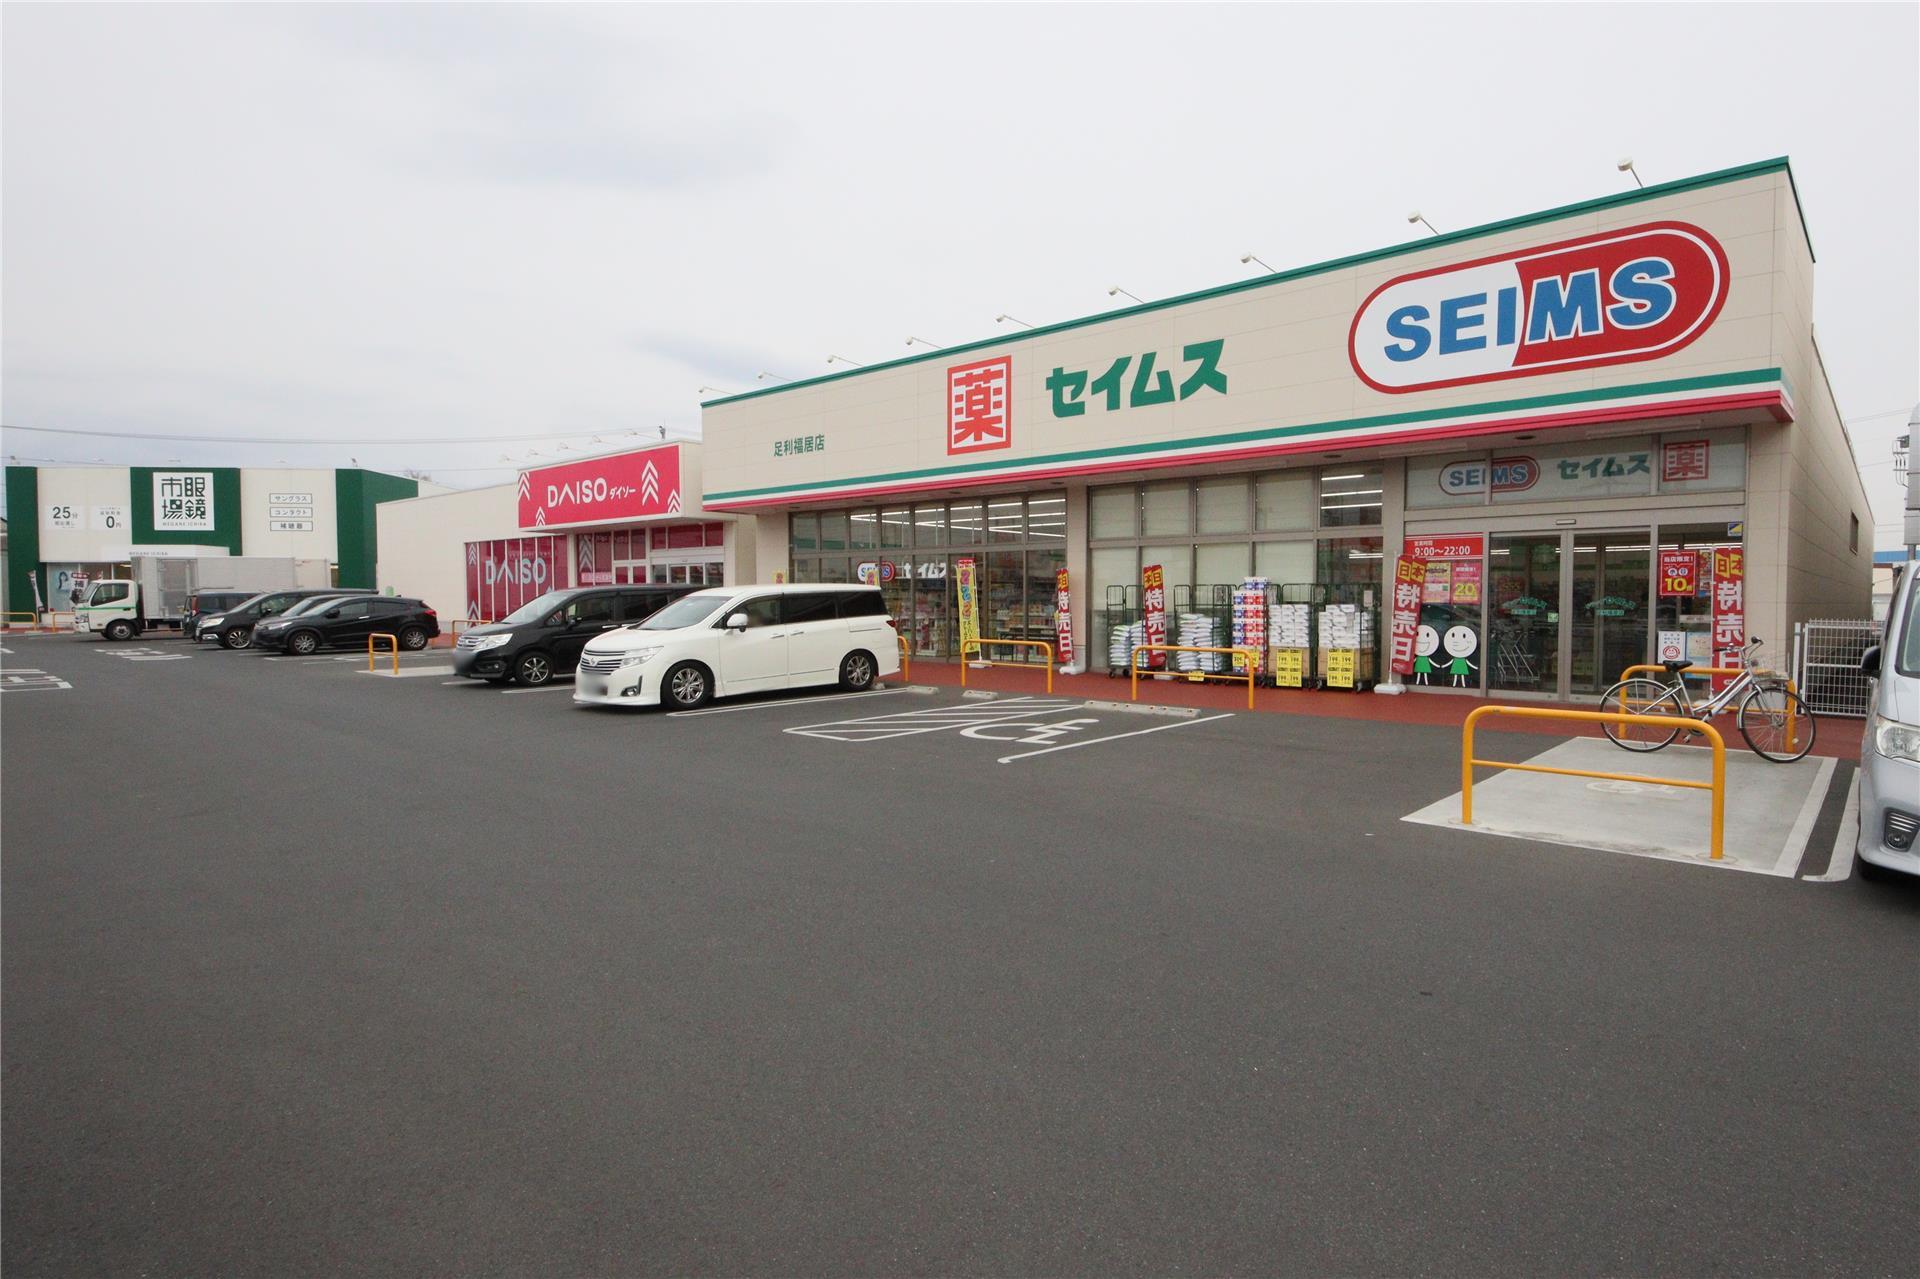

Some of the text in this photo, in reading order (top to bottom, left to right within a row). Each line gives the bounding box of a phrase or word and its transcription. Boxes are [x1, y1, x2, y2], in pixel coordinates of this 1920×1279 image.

[1384, 256, 1677, 362] SEIMS
[1045, 339, 1227, 418] セイムス
[953, 367, 1005, 444] 薬
[774, 434, 824, 456] 足利福居店
[1449, 464, 1528, 487] SEIMS
[1557, 453, 1650, 480] セイムス
[1666, 444, 1707, 478] 薬
[547, 478, 607, 508] DAISO
[609, 485, 636, 500] ダイソー
[485, 557, 546, 584] DAISO
[1145, 588, 1166, 655] 特売日
